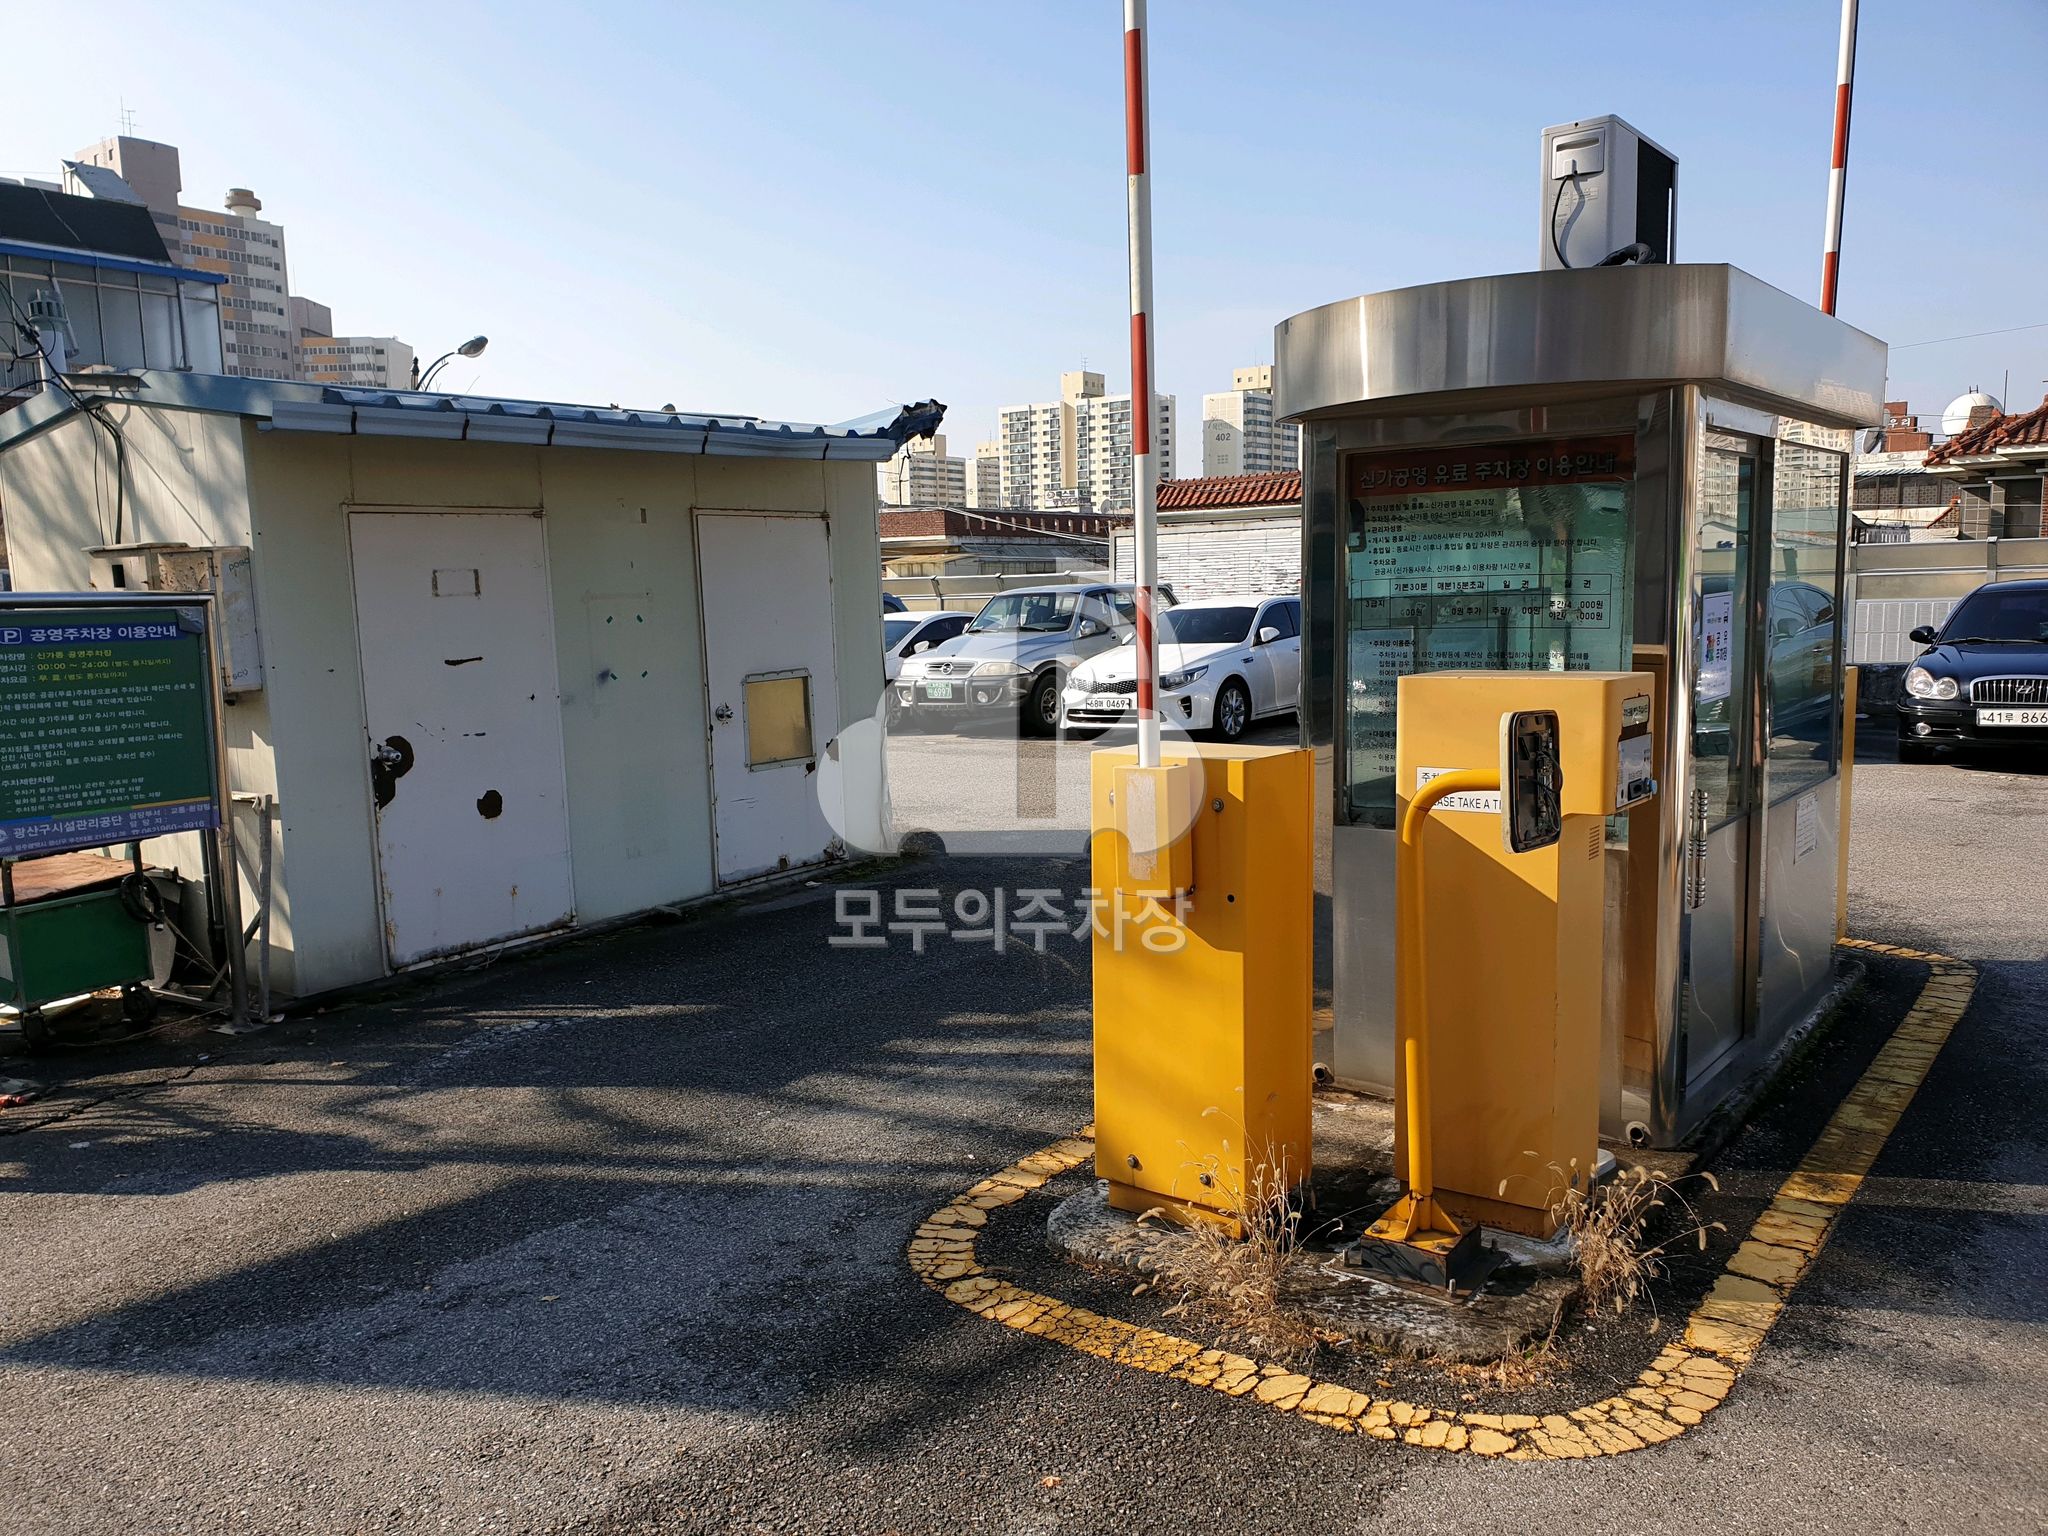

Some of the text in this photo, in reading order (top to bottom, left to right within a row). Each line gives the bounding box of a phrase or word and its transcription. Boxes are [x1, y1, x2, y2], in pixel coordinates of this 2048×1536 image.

[1887, 417, 1910, 428] 우리
[1215, 432, 1231, 441] 402
[1360, 453, 1615, 489] 신가공영 유료 주차장 이용안내
[1371, 525, 1402, 534] 관리자성명
[1392, 534, 1417, 544] 종료시간
[1396, 544, 1423, 553] 종료시간
[1444, 542, 1463, 551] 휴업일
[1465, 541, 1478, 550] 출입
[1480, 540, 1500, 550] 차량은
[1502, 539, 1529, 549] 관리자의
[1373, 558, 1397, 567] 주차요금
[1374, 567, 1393, 576] 관공서
[1472, 562, 1498, 572] 이용차량
[1518, 562, 1532, 570] 무료
[1394, 583, 1428, 591] 기본30분
[1437, 580, 1485, 591] 매분15분초과
[1365, 599, 1385, 608] 3급지
[30, 627, 112, 642] 공영주차장
[118, 625, 177, 639] 이용안내
[1373, 640, 1391, 648] 주차장
[67, 649, 112, 660] 공영주차장
[37, 662, 66, 671] 00:00
[81, 661, 109, 669] 24:00
[1106, 699, 1126, 708] 0469
[1986, 712, 2014, 723] 41루
[1458, 797, 1481, 809] TAKE
[1483, 799, 1490, 808] A
[13, 815, 122, 839] 광산구시설관리공단
